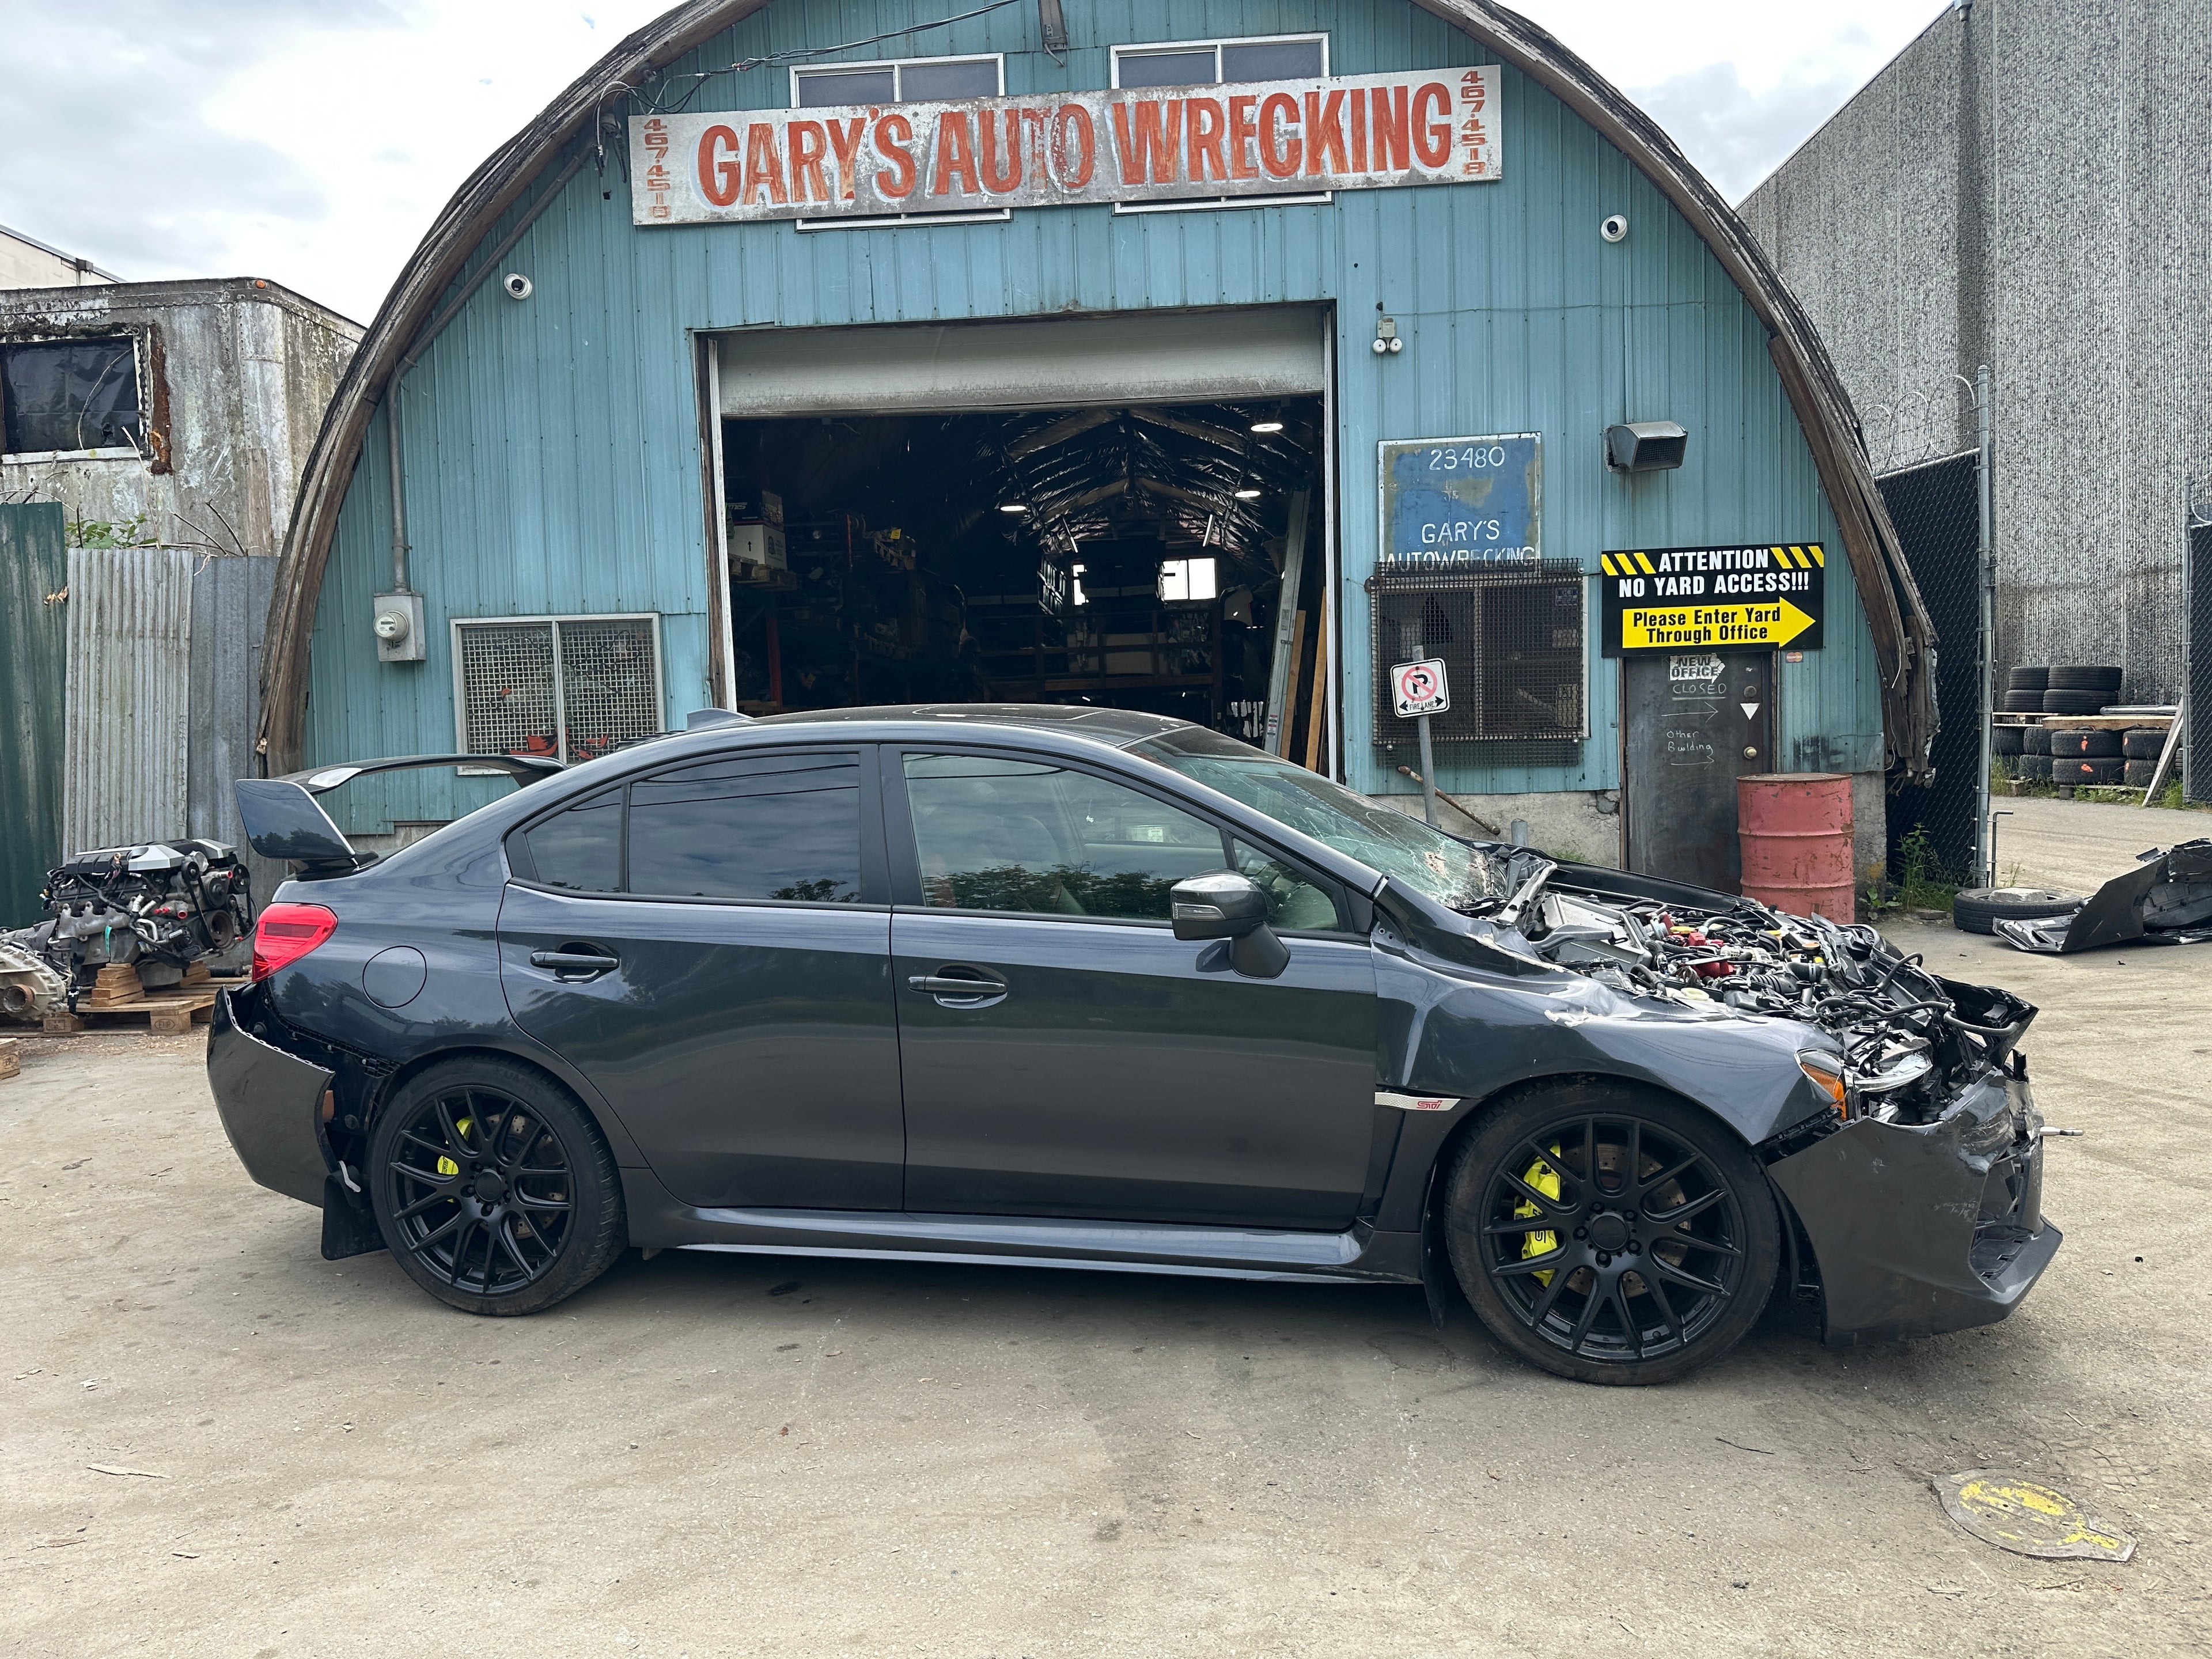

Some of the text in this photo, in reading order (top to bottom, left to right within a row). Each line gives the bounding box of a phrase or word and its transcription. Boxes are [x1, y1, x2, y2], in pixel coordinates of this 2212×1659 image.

[697, 82, 1452, 207] GARY'S AUTO WRECKING
[1429, 446, 1505, 470] 23480
[1422, 520, 1499, 543] GARY'S
[1658, 549, 1768, 572] ATTENTION
[1619, 571, 1809, 598] NO YARD ACCESS!!!
[1633, 607, 1781, 627] Please Enter Yard
[1646, 624, 1768, 644] Through Office
[1677, 656, 1711, 667] NEW
[1672, 666, 1718, 677] OFFICE
[1673, 683, 1727, 695] CLOSED
[1409, 702, 1421, 711] FIRE
[1666, 730, 1699, 739] Other
[1668, 741, 1714, 756] Building
[1416, 1100, 1443, 1110] STI
